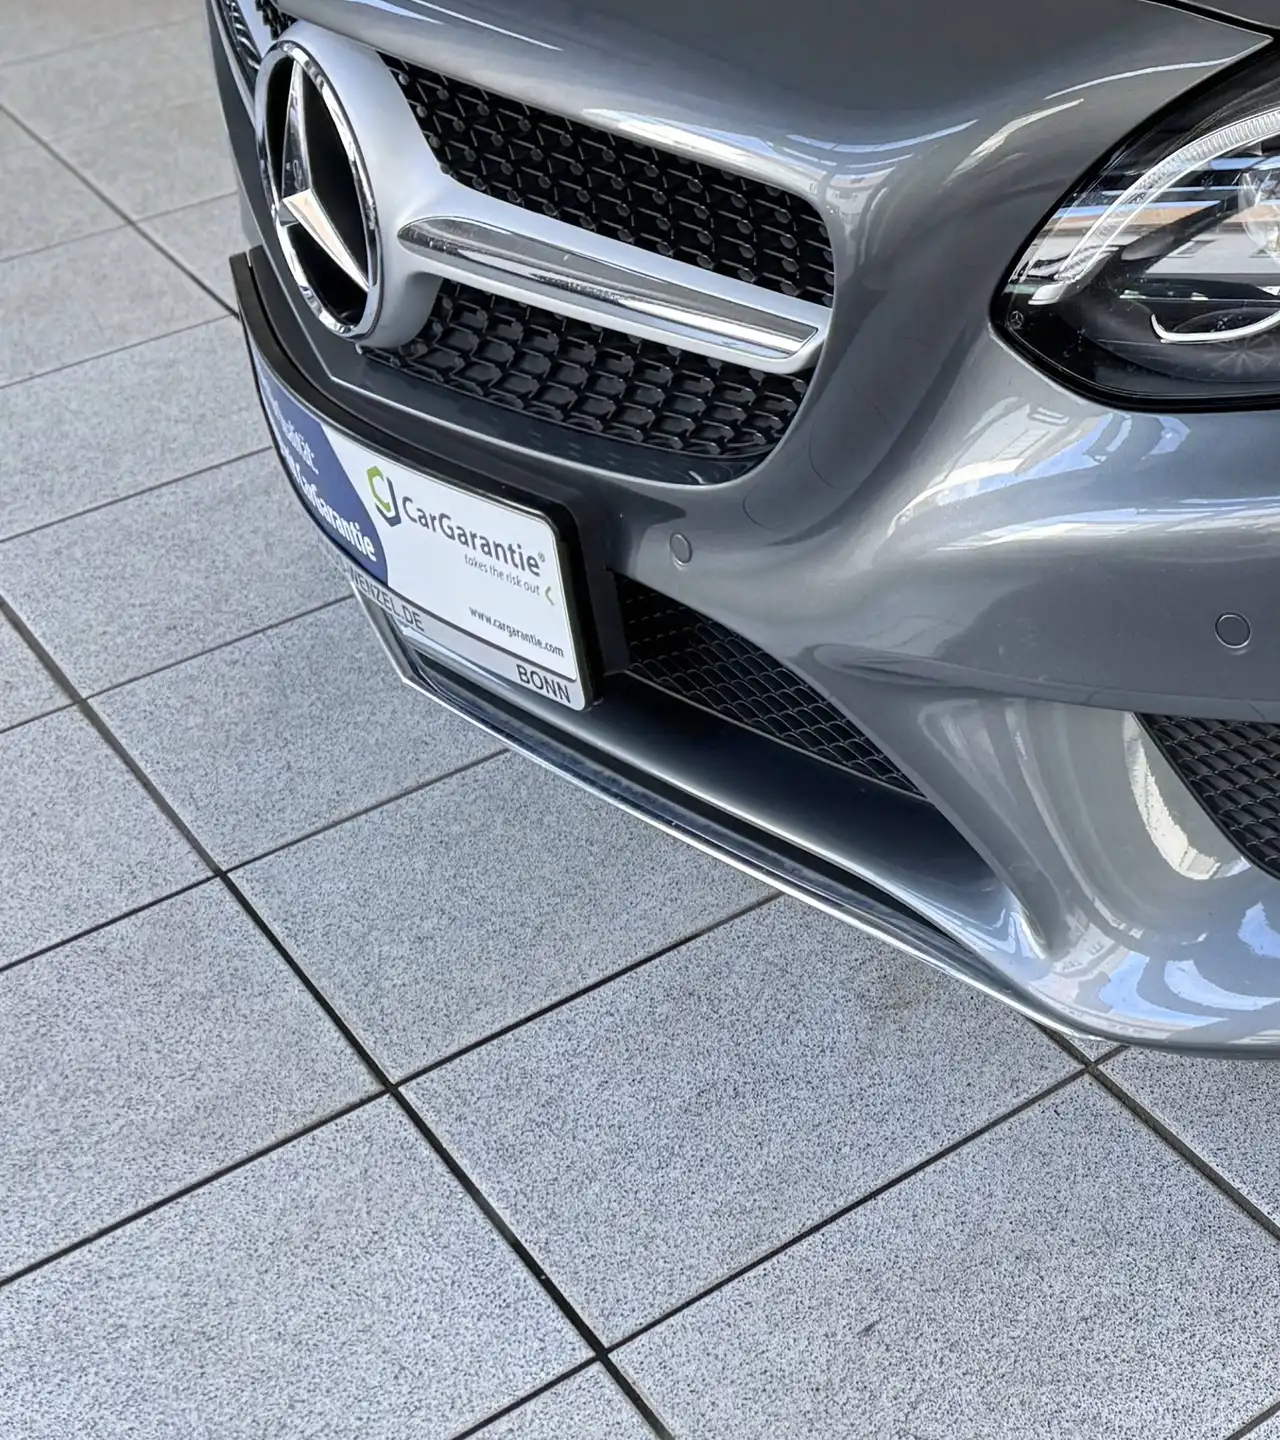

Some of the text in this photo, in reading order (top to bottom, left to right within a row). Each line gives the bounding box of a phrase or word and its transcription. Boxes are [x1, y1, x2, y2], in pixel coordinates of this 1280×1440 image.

[464, 553, 541, 597] takes the risk out
[469, 606, 566, 660] www.cargarantie.com
[516, 662, 573, 705] BONN
